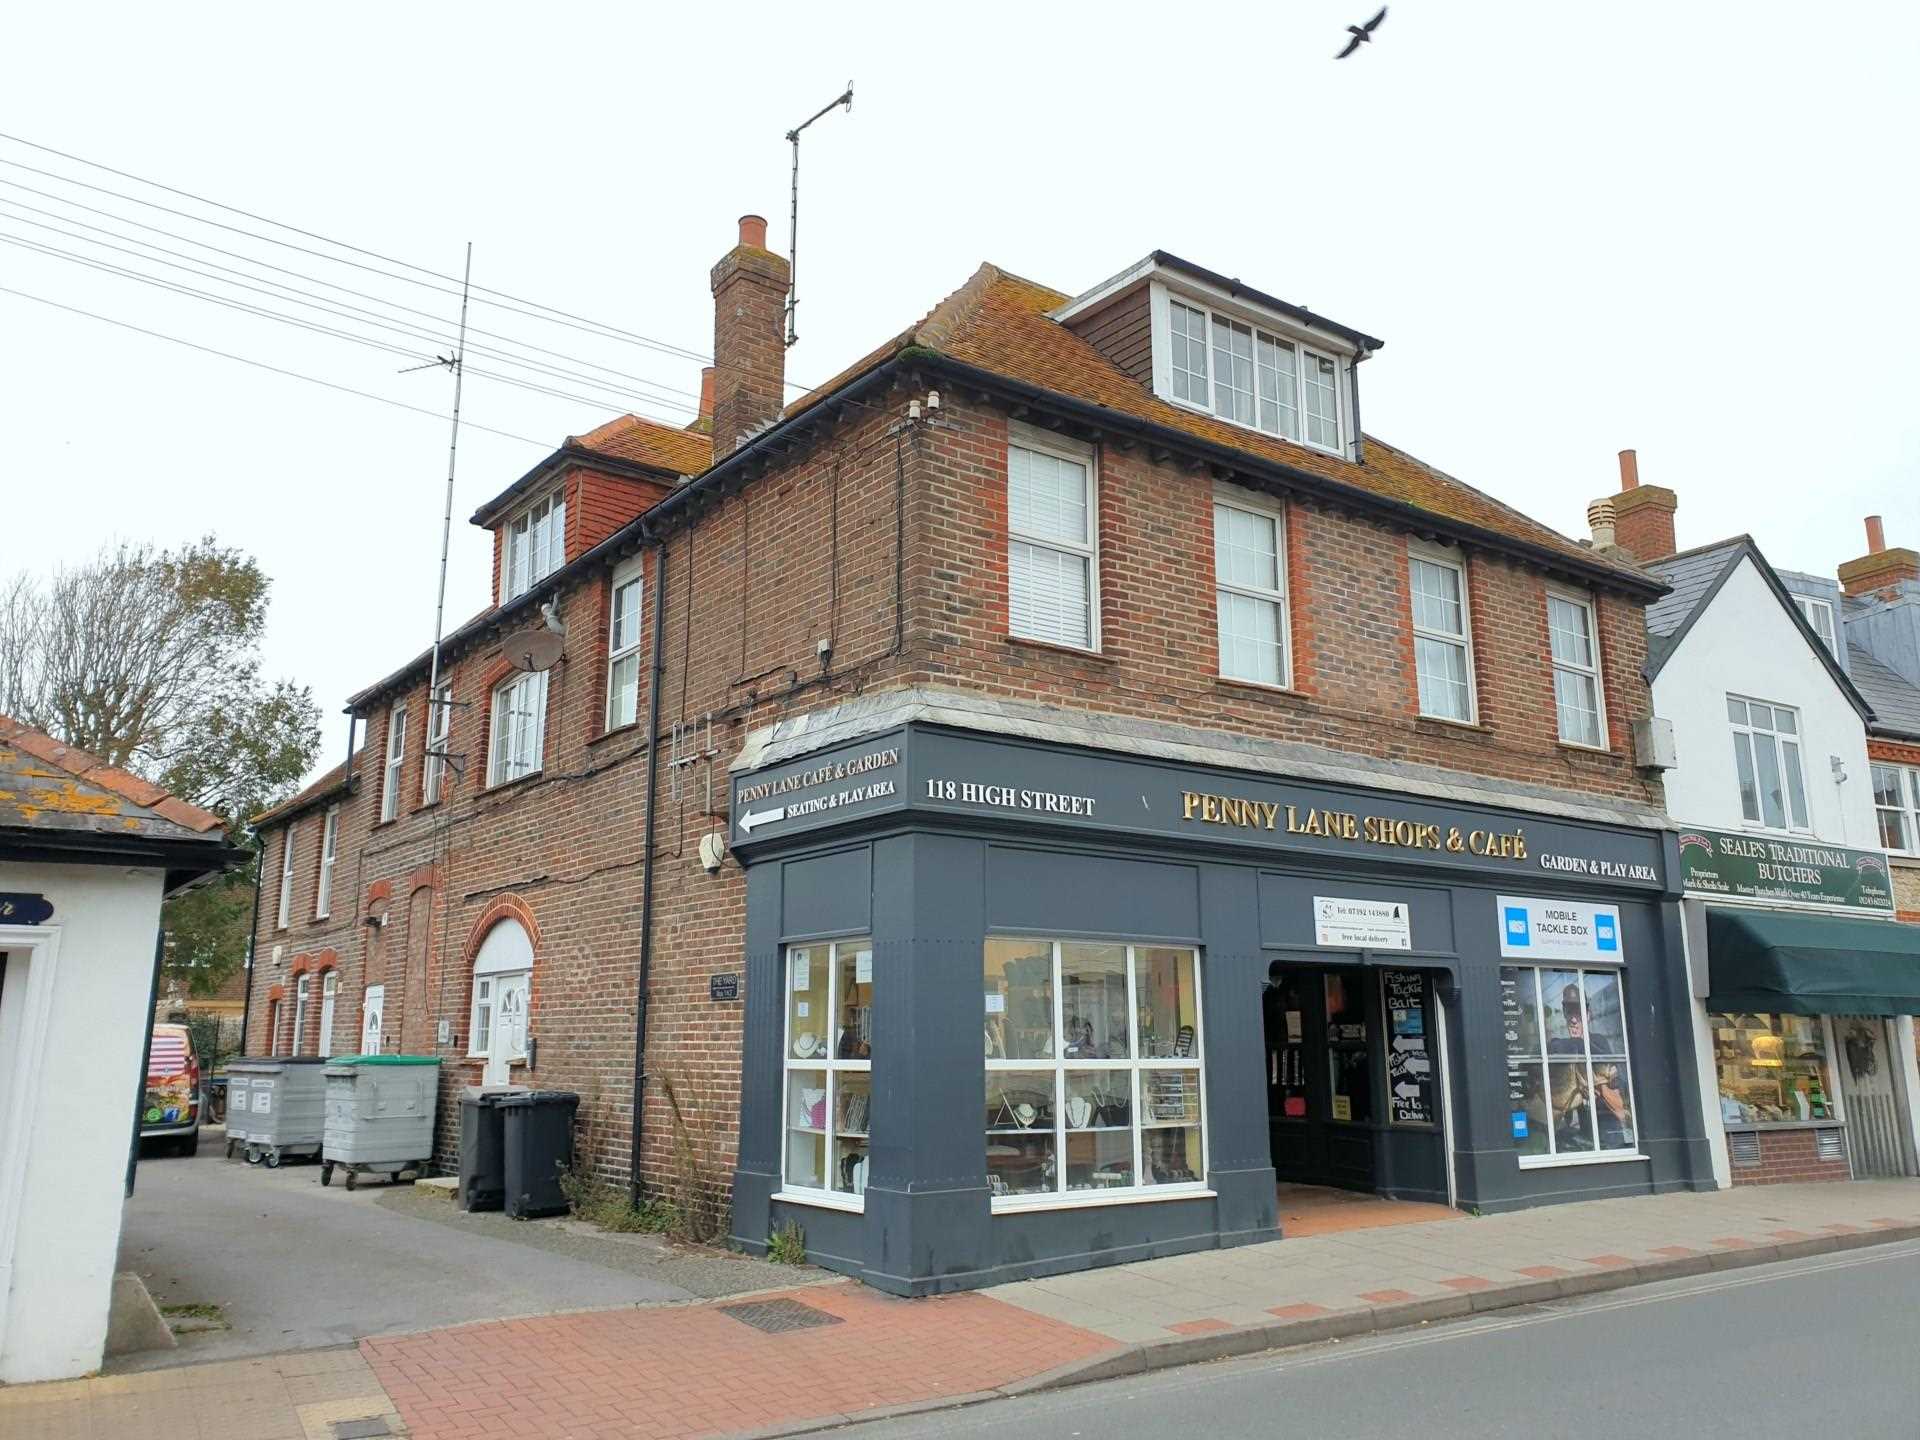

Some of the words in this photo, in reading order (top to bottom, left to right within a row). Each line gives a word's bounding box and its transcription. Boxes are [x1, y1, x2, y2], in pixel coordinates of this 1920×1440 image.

[737, 783, 771, 804] PENNY
[772, 775, 801, 795] LANE
[803, 762, 832, 787] CAFÉ
[835, 763, 845, 778] &
[847, 748, 898, 775] GARDEN
[787, 794, 827, 818] SEATING
[829, 794, 838, 807] &
[839, 787, 866, 805] PLAY
[866, 780, 895, 798] AREA
[927, 779, 956, 799] 118
[961, 783, 1016, 807] HIGH
[1020, 790, 1095, 816] STREET
[1182, 791, 1279, 830] PENNY
[1286, 805, 1358, 840] LANE
[1364, 816, 1440, 849] SHOPS
[1446, 827, 1464, 852] &
[1469, 829, 1527, 859] CAFÉ
[1540, 854, 1587, 874] GARDEN
[1589, 860, 1599, 874] &
[1600, 861, 1626, 877] PLAY
[1628, 865, 1657, 881] AREA
[1720, 837, 1765, 859] SEALE'S
[1768, 844, 1850, 868] TRADITIONAL
[1757, 863, 1822, 885] BUTCHERS
[1536, 923, 1569, 935] TACKLE
[1570, 925, 1589, 936] BOX
[1545, 910, 1577, 921] MOBILE
